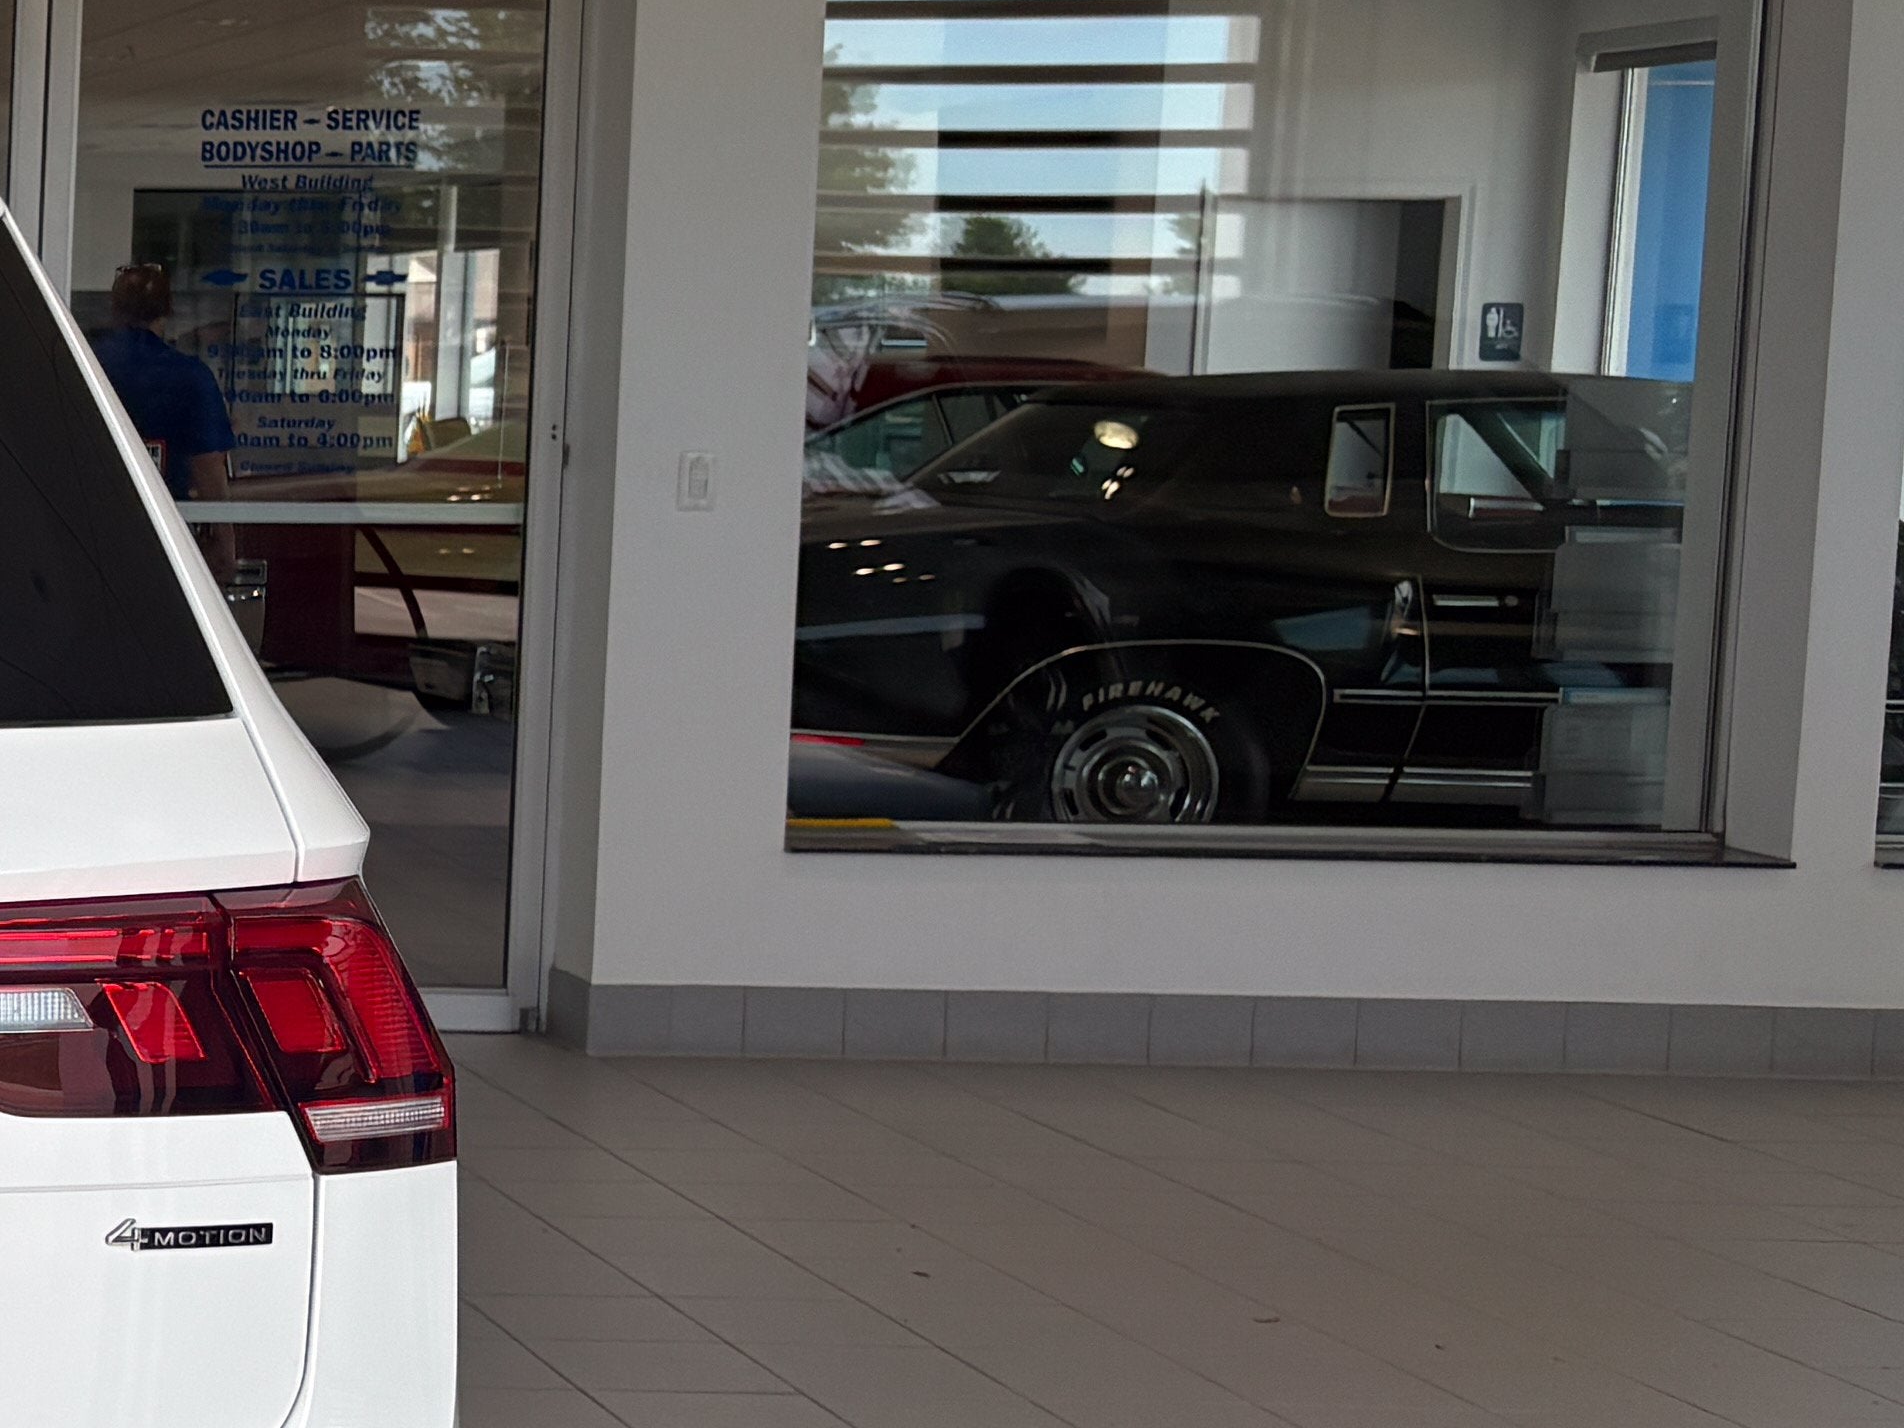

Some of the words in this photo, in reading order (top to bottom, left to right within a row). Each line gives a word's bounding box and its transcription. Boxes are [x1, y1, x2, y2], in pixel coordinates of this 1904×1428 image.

[200, 108, 298, 132] CASHIER
[325, 108, 422, 132] SERVICE
[200, 139, 322, 163] BODYSHOP
[349, 140, 418, 163] PARTS
[241, 174, 287, 190] West
[294, 174, 374, 193] Building
[259, 268, 353, 291] SALES
[288, 303, 367, 322] Building
[105, 1218, 268, 1252] 4MOTION
